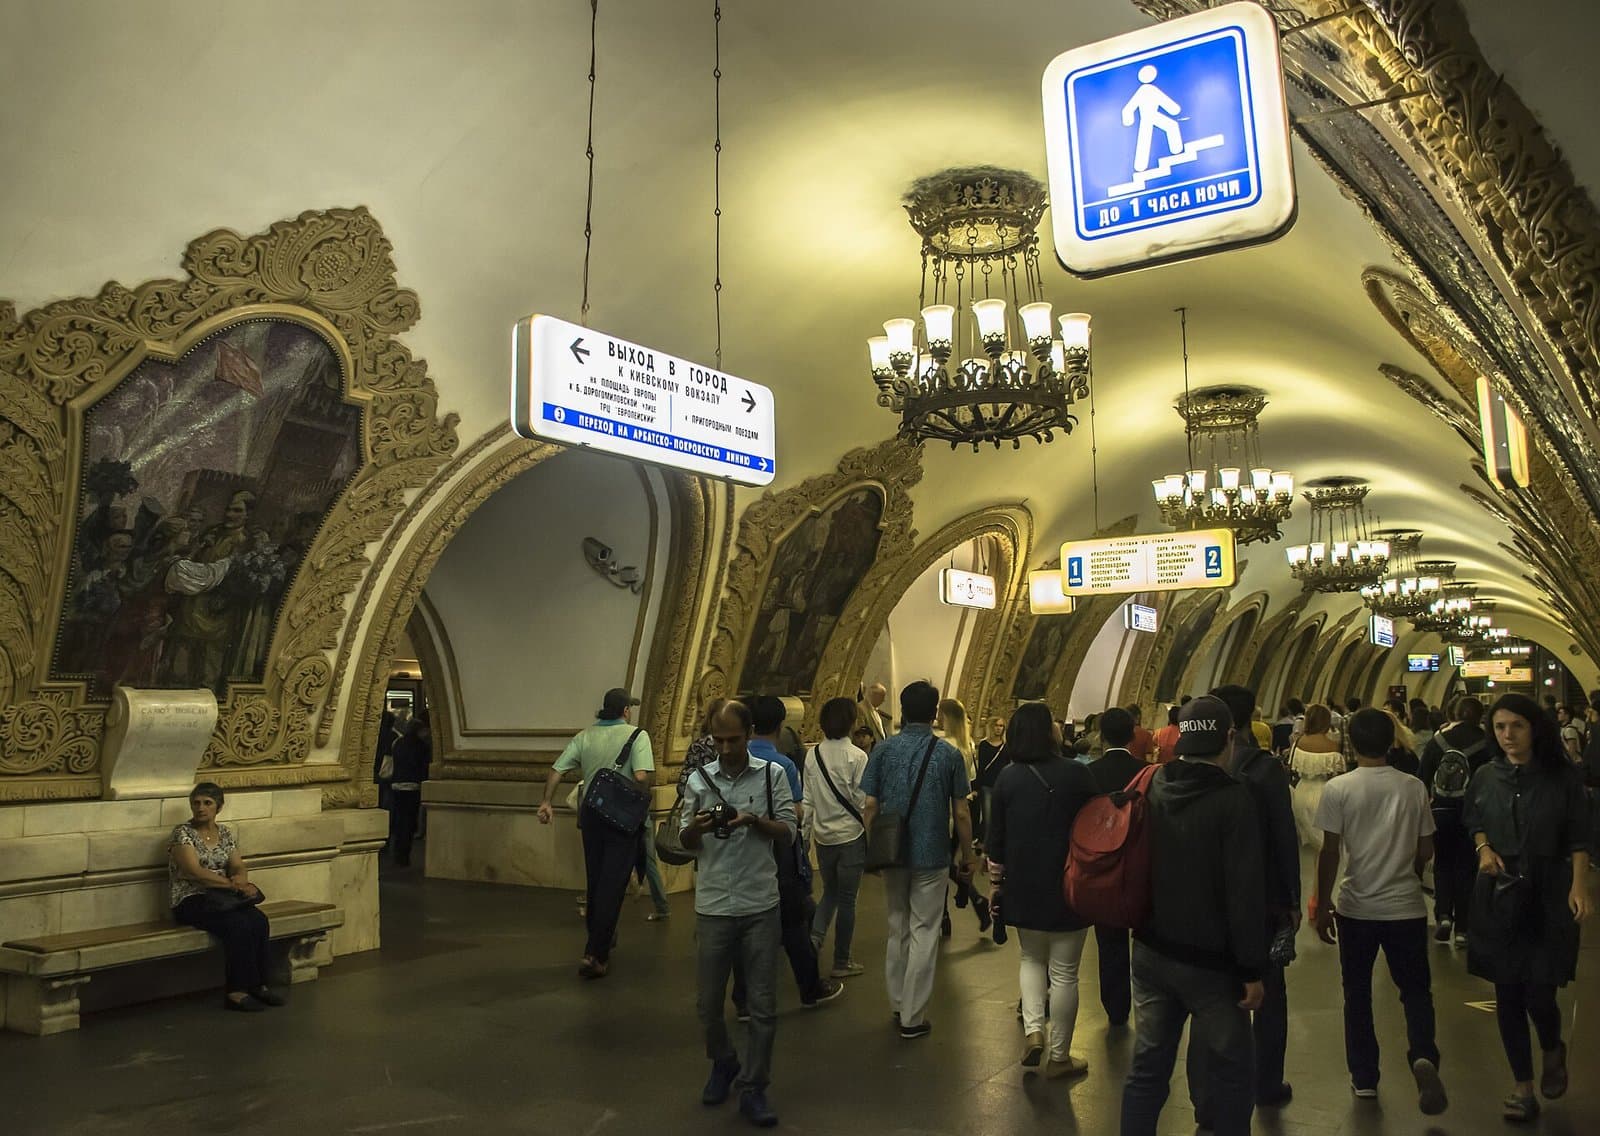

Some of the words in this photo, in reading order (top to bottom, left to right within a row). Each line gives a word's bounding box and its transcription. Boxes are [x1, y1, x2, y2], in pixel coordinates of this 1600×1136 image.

[1099, 206, 1120, 227] ДО
[1129, 197, 1140, 217] 1
[1147, 191, 1191, 213] ЧАСА
[1195, 179, 1240, 204] НОЧИ
[608, 341, 655, 372] ВЫХОД
[669, 361, 675, 375] В
[690, 367, 728, 394] ГОРОД
[590, 376, 597, 384] НА
[601, 377, 630, 394] ПЛОЩАДЬ
[634, 387, 657, 401] ЕВРОПЫ
[618, 366, 623, 377] К
[630, 369, 679, 393] КИЕВСКОМУ
[685, 386, 721, 405] ВОКЗАЛУ
[600, 402, 611, 414] ТРЦ
[692, 414, 731, 433] ПРИГОРОДНЫМ
[735, 426, 759, 440] ПОЕЗДАМ
[579, 415, 614, 435] ПЕРЕХОД
[617, 424, 628, 437] НА
[726, 451, 751, 466] ЛИНИЮ
[1071, 560, 1078, 576] 1
[1208, 550, 1218, 567] 2
[1179, 719, 1217, 733] BRONX
